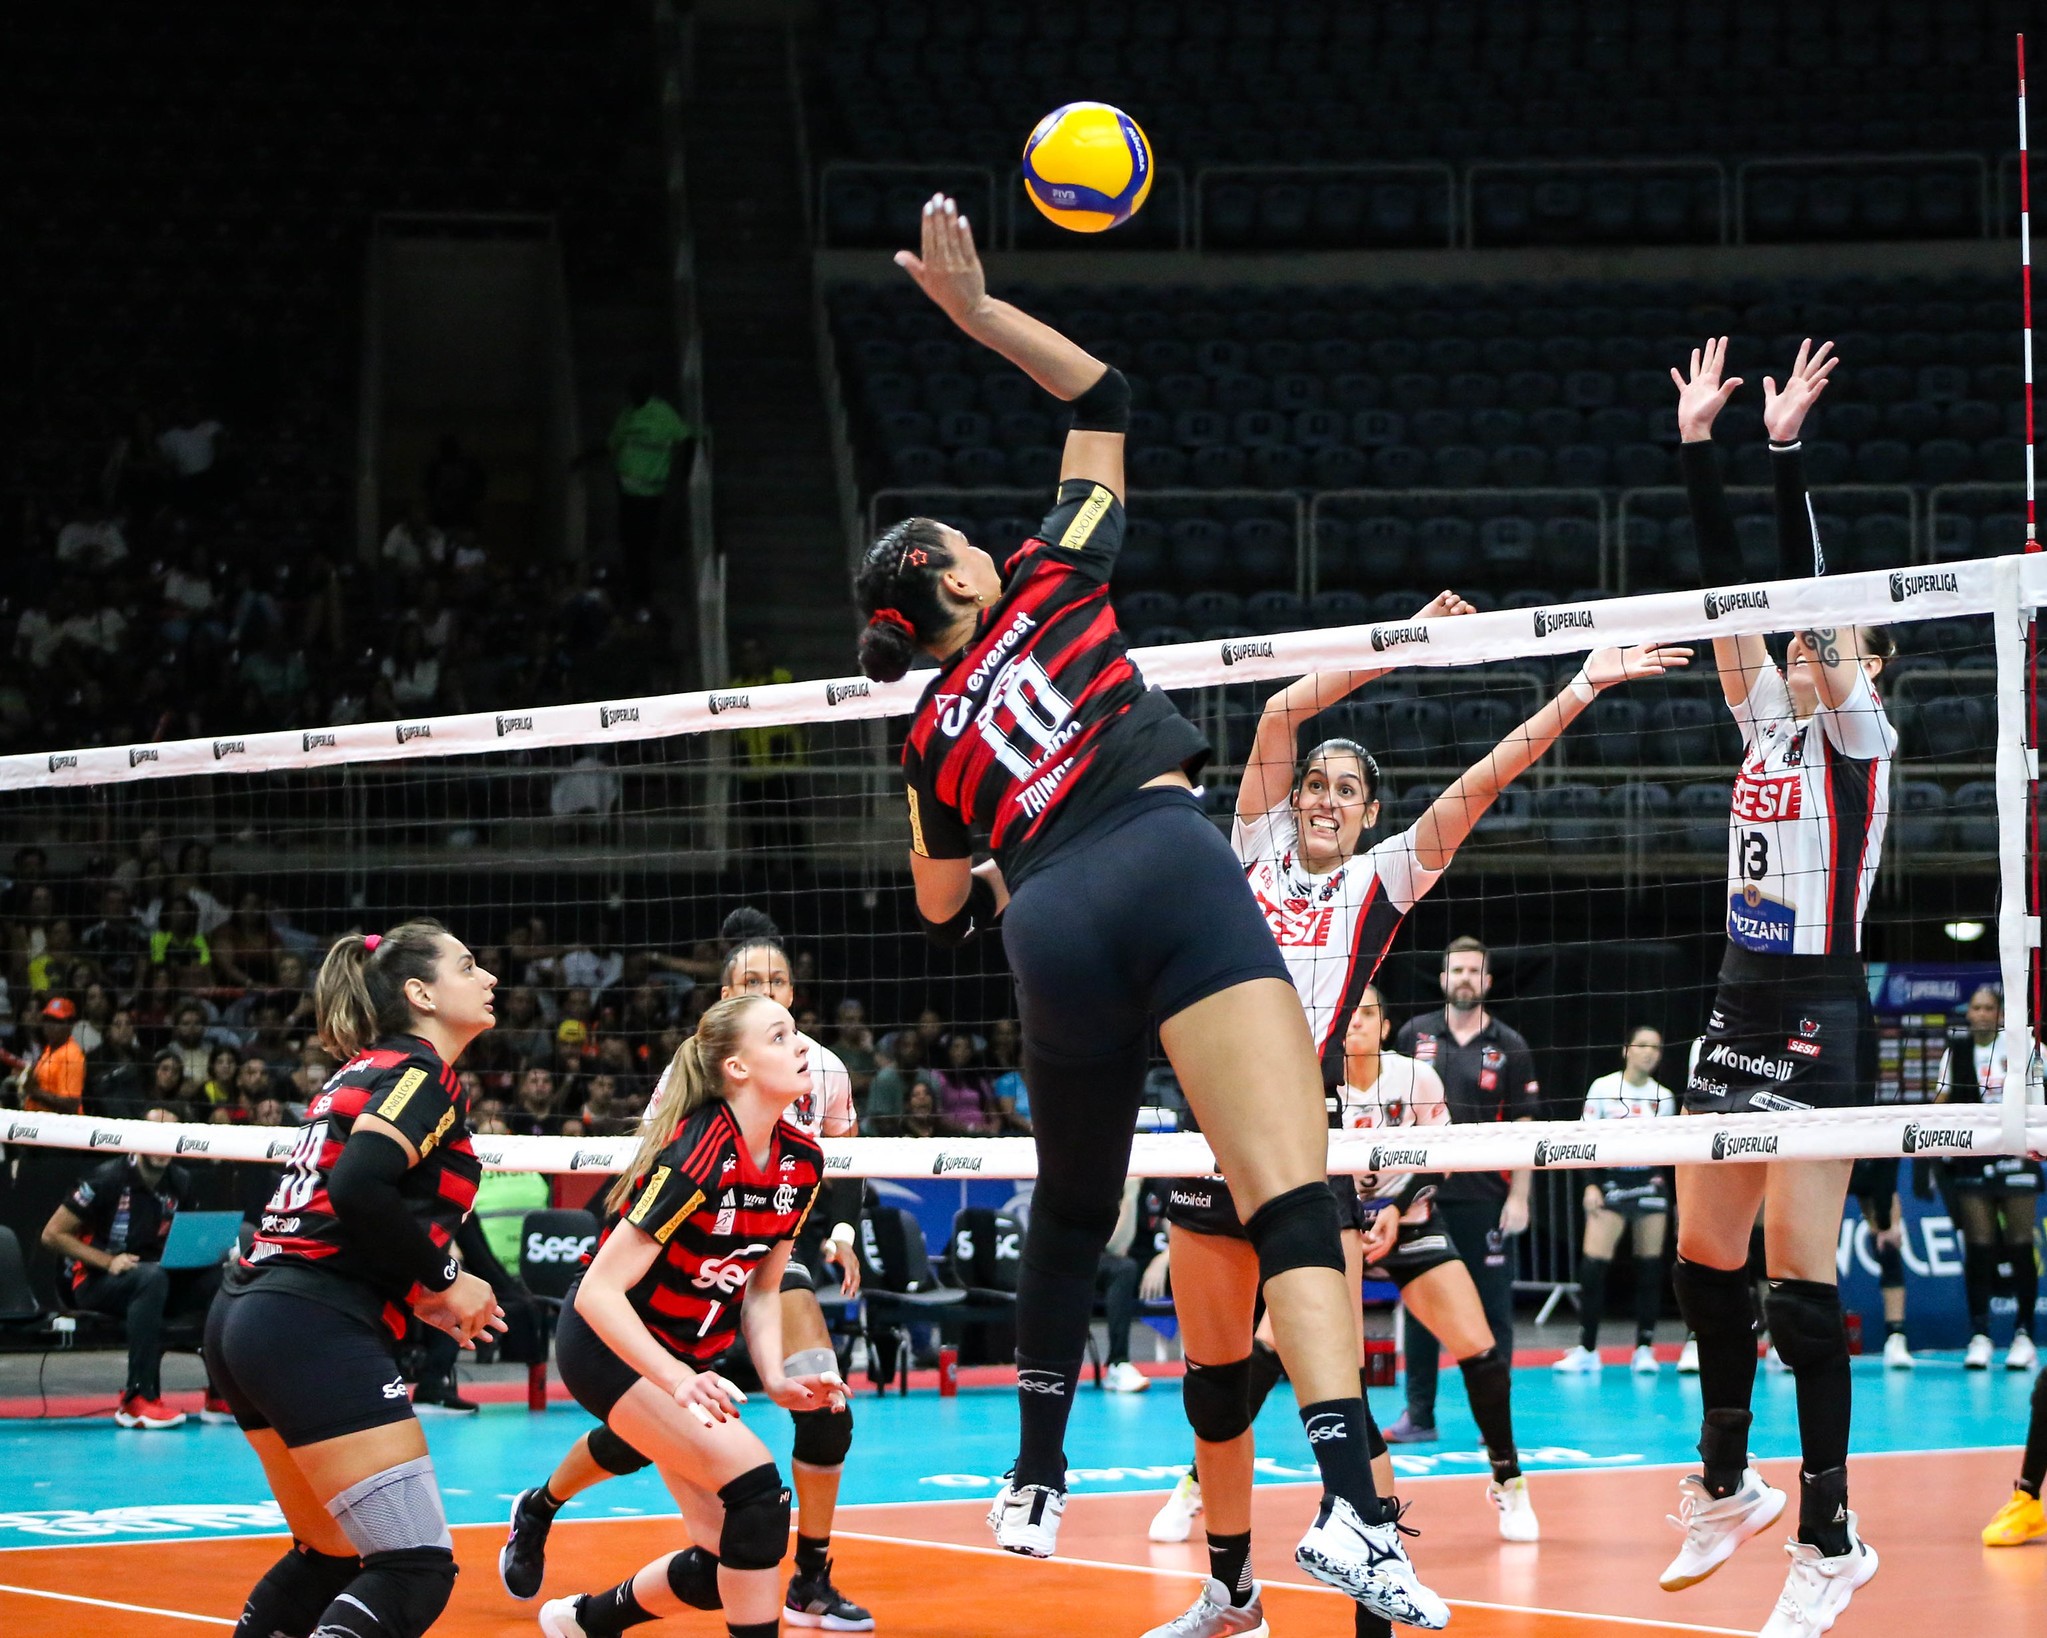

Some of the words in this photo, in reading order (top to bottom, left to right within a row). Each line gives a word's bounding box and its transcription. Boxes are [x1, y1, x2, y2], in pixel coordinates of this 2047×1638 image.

[1052, 188, 1076, 199] FIVB
[1904, 571, 1959, 597] SUPERLIGA
[1717, 589, 1770, 615] SUPERLIGA
[1547, 609, 1595, 633] SUPERLIGA
[1382, 625, 1430, 647] SUPERLIGA
[966, 610, 1037, 692] everest
[1232, 640, 1275, 663] SUPERLIGA
[717, 693, 751, 712] SUPERLIGA
[835, 681, 871, 702] SUPERLIGA
[504, 715, 534, 733] SUPERLIGA
[609, 706, 640, 725] SUPERLIGA
[980, 650, 1075, 783] 10
[403, 724, 433, 740] SUPERLIGA
[1732, 777, 1794, 819] SESI
[1738, 827, 1769, 881] 13
[1789, 1040, 1818, 1057] SESI
[1706, 1043, 1795, 1082] Mondelli
[1725, 1134, 1779, 1157] SUPERLIGA
[1917, 1129, 1974, 1151] SUPERLIGA
[579, 1153, 614, 1168] SUPERLIGA
[823, 1156, 852, 1171] PERLIGA
[1381, 1149, 1428, 1168] SUPERLIGA
[1547, 1142, 1597, 1163] SUPERLIGA
[943, 1156, 983, 1172] SUPERLIGA
[696, 1299, 722, 1338] 1
[1309, 1422, 1348, 1444] esc
